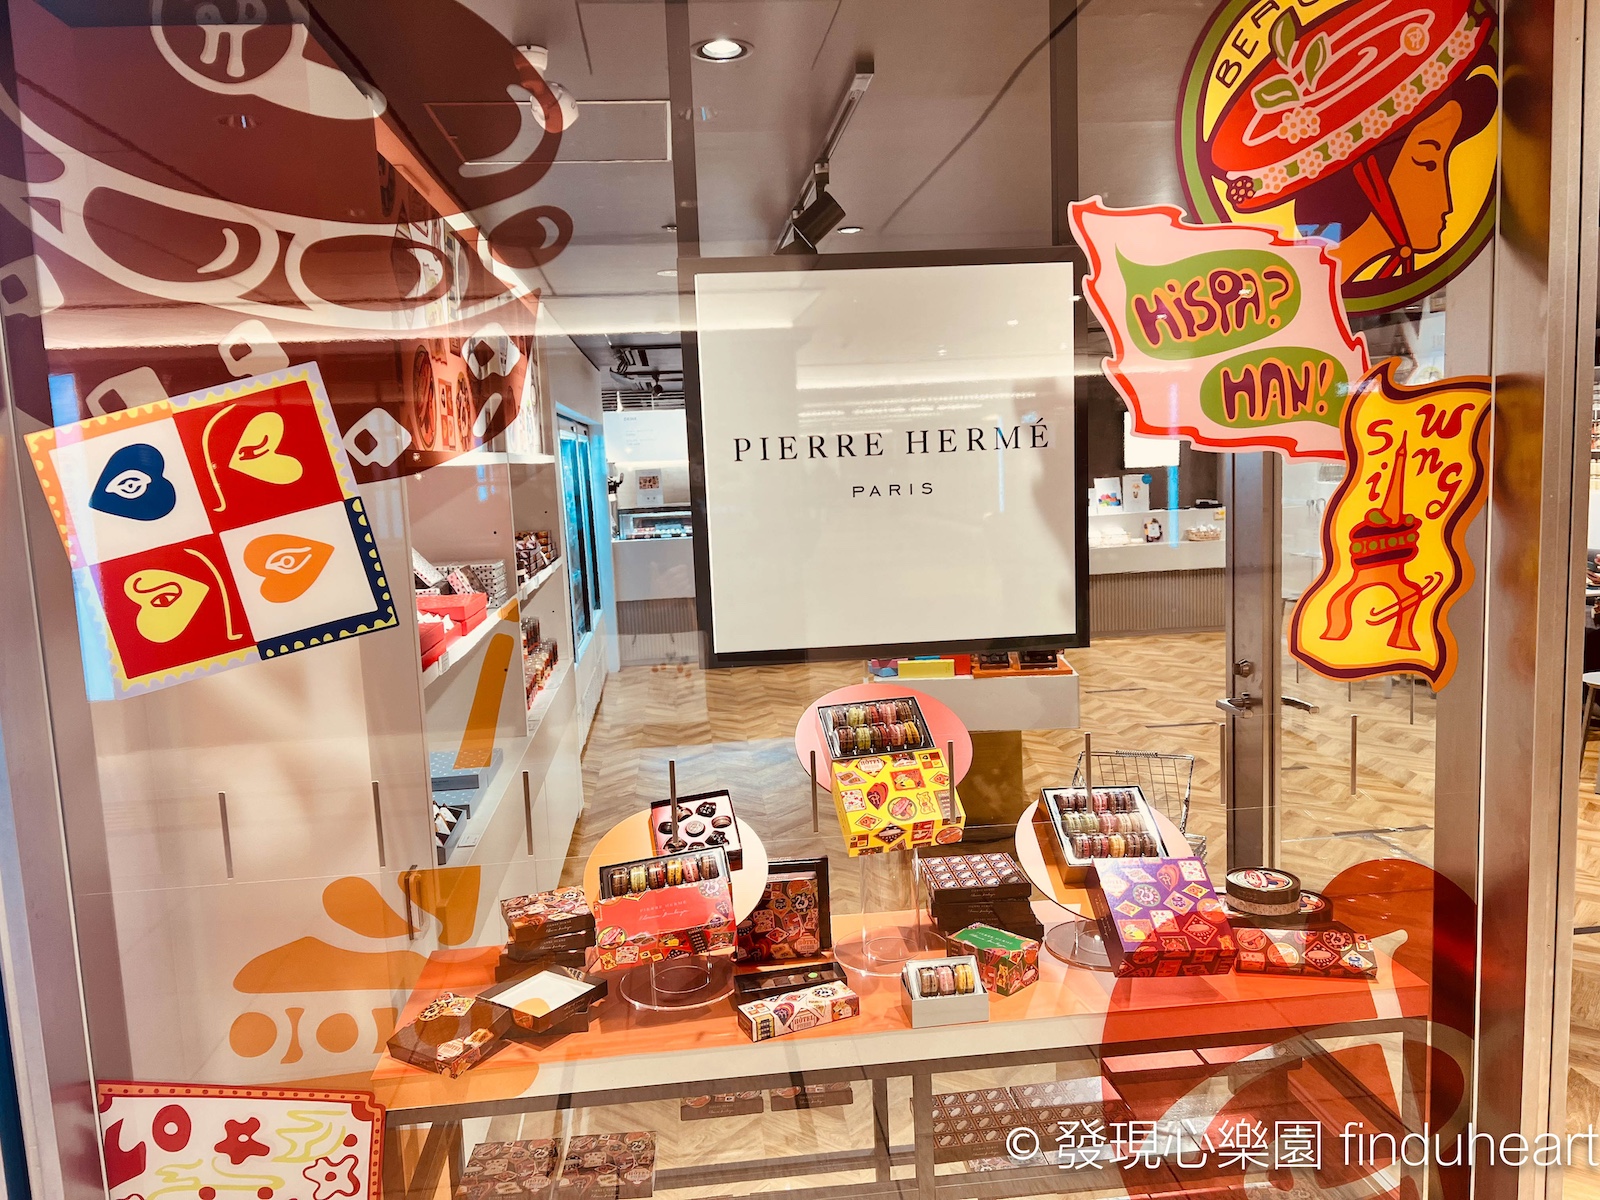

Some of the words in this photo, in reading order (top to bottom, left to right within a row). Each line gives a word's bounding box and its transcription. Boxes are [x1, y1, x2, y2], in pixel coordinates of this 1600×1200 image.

[1221, 359, 1333, 421] HAN!
[733, 431, 884, 462] PIERRE
[905, 417, 1049, 455] HERMÉ
[852, 482, 933, 498] PARIS
